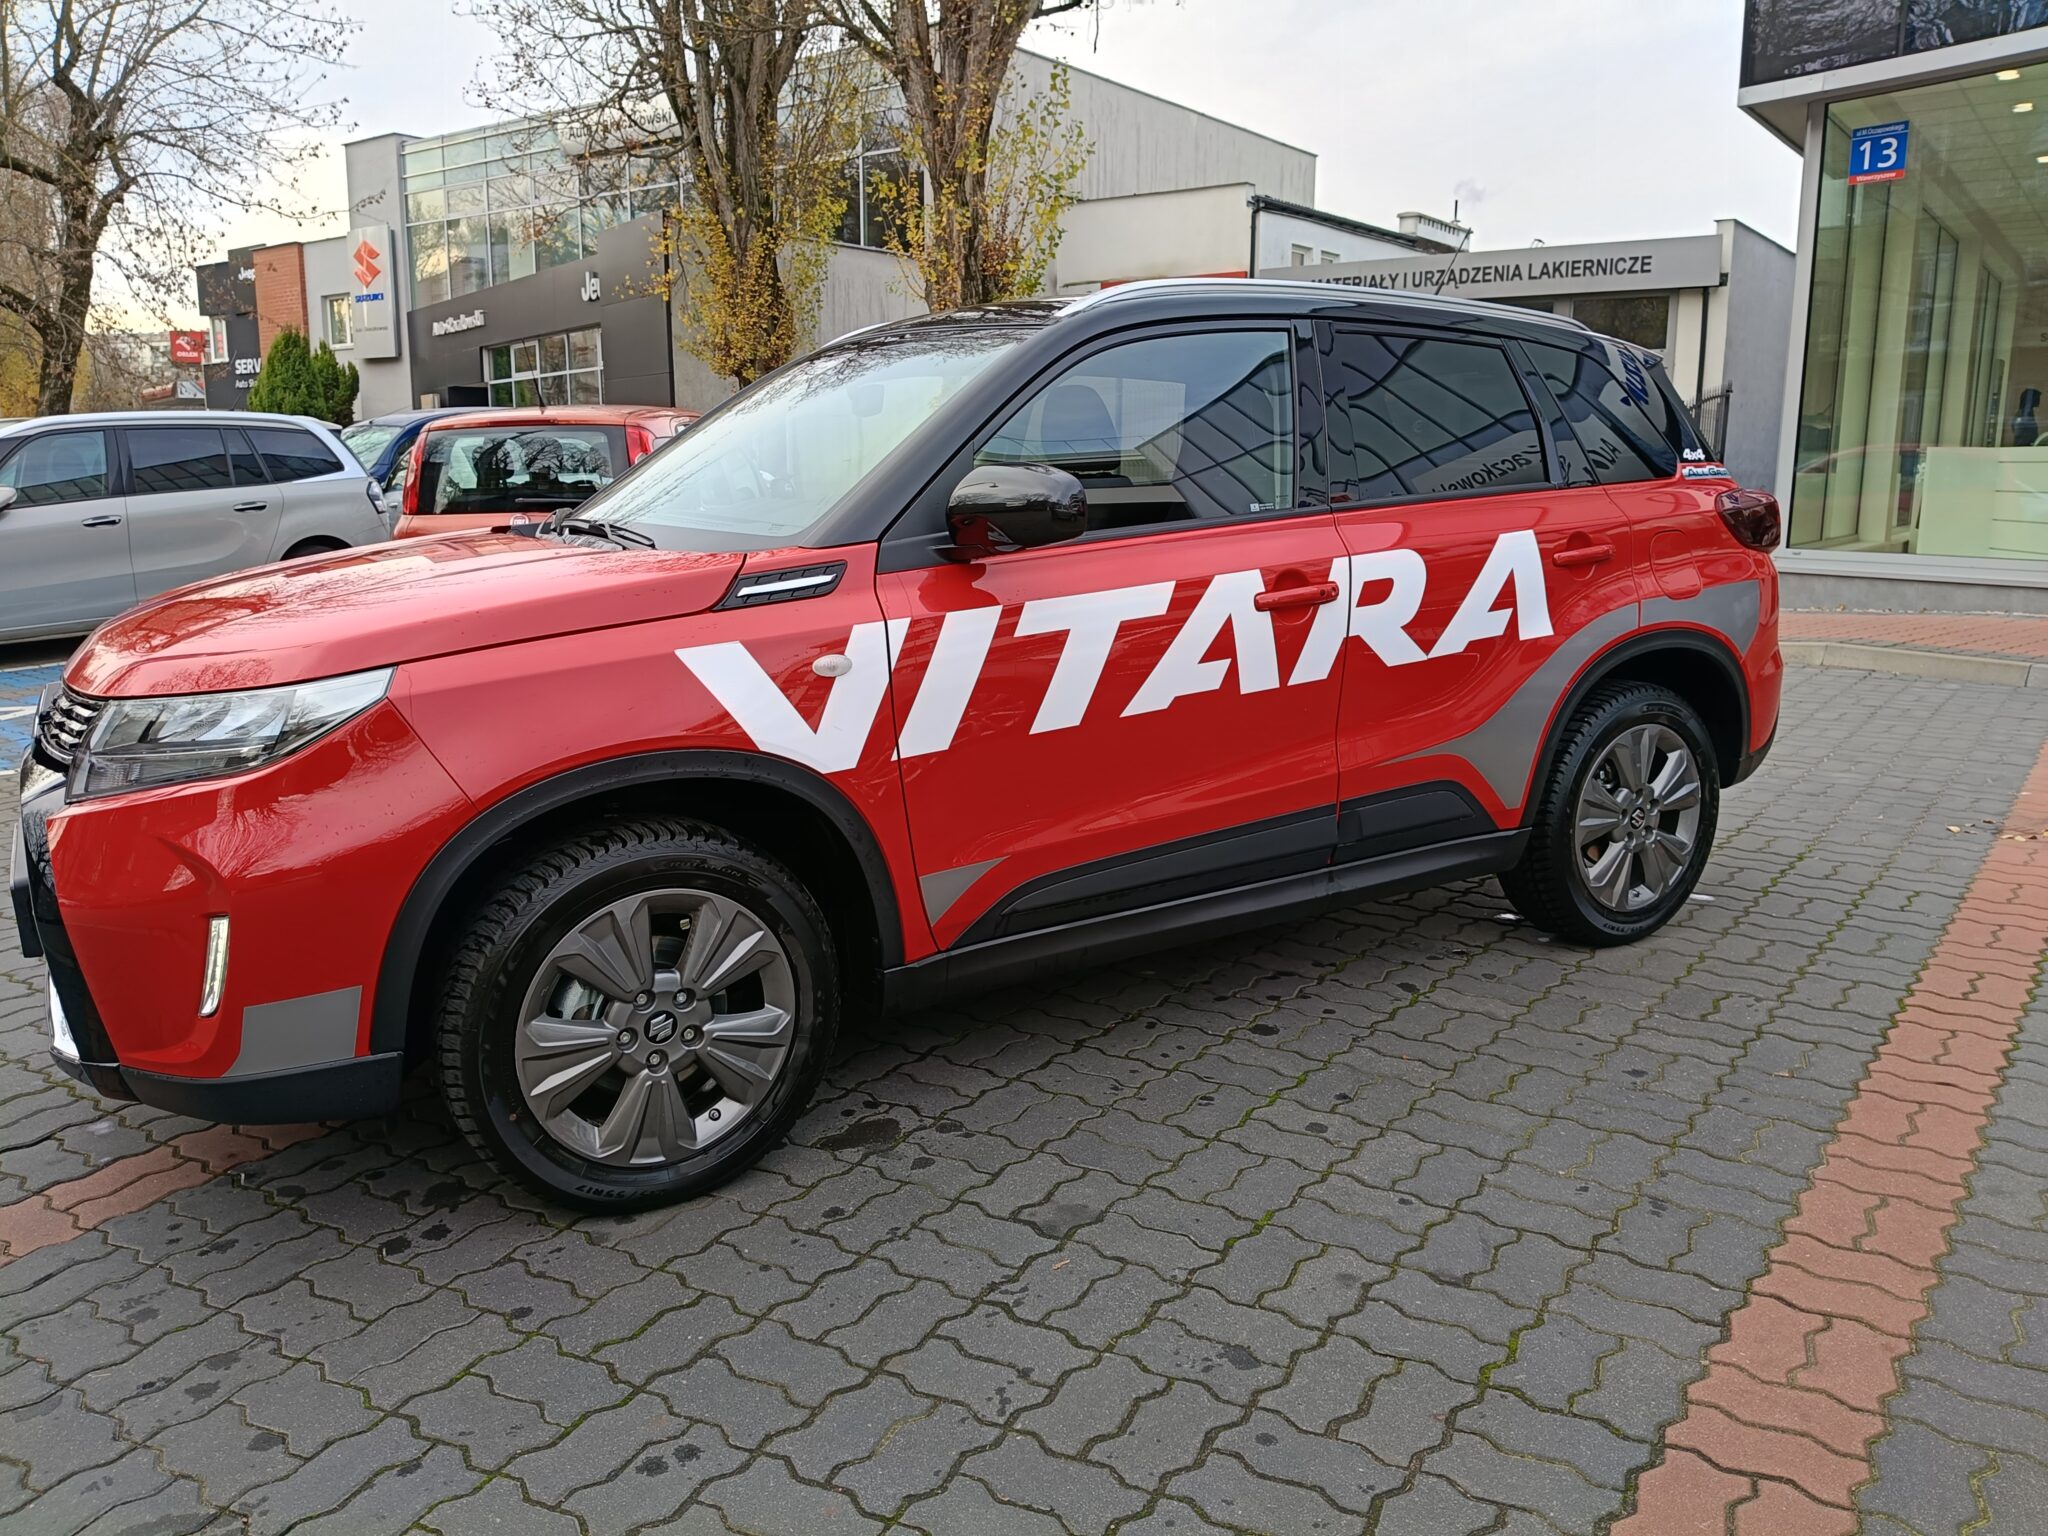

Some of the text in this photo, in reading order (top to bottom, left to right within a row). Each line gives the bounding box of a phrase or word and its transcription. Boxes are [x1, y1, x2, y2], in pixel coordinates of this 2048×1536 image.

[1859, 137, 1898, 170] 13
[1311, 255, 1653, 290] ERIAŁY I URZĄDZENIA LAKIERNICZE
[1683, 448, 1706, 461] 4x4
[674, 528, 1556, 775] VITARA
